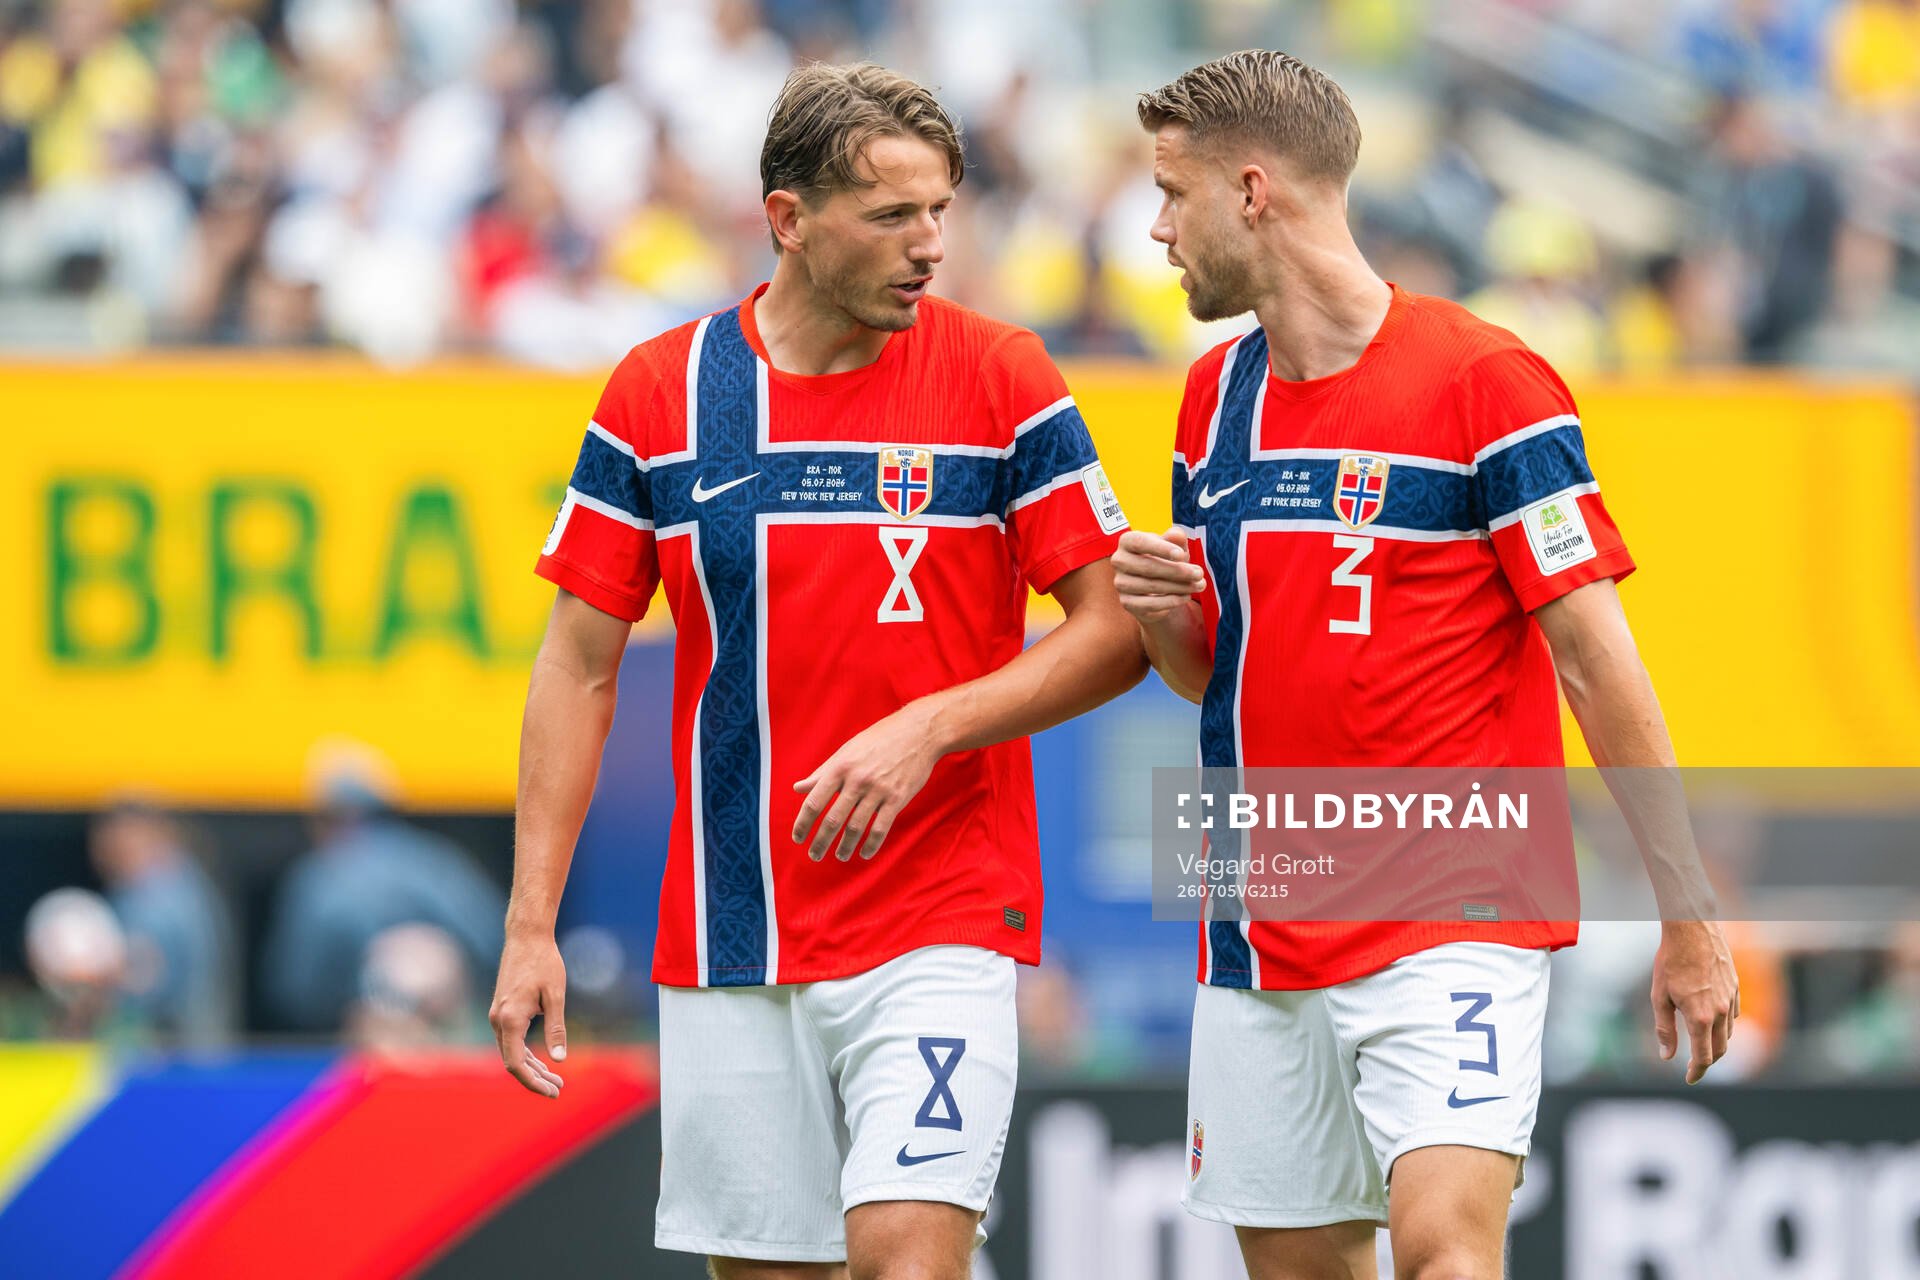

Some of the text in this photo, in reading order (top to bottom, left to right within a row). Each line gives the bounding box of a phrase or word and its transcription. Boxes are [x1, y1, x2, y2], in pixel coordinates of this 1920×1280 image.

[806, 465, 820, 475] BRA
[828, 465, 842, 475] NOR
[801, 478, 846, 488] 05.07.2026
[781, 491, 863, 502] NEW YORK NEW JERSEY
[1273, 497, 1290, 508] YORK
[1543, 534, 1585, 559] EDUCATION
[1560, 551, 1576, 561] FIFA
[45, 474, 568, 665] BRA
[877, 526, 929, 624] 8
[1328, 533, 1375, 636] 3
[1450, 991, 1499, 1076] 3
[914, 1037, 966, 1132] 8
